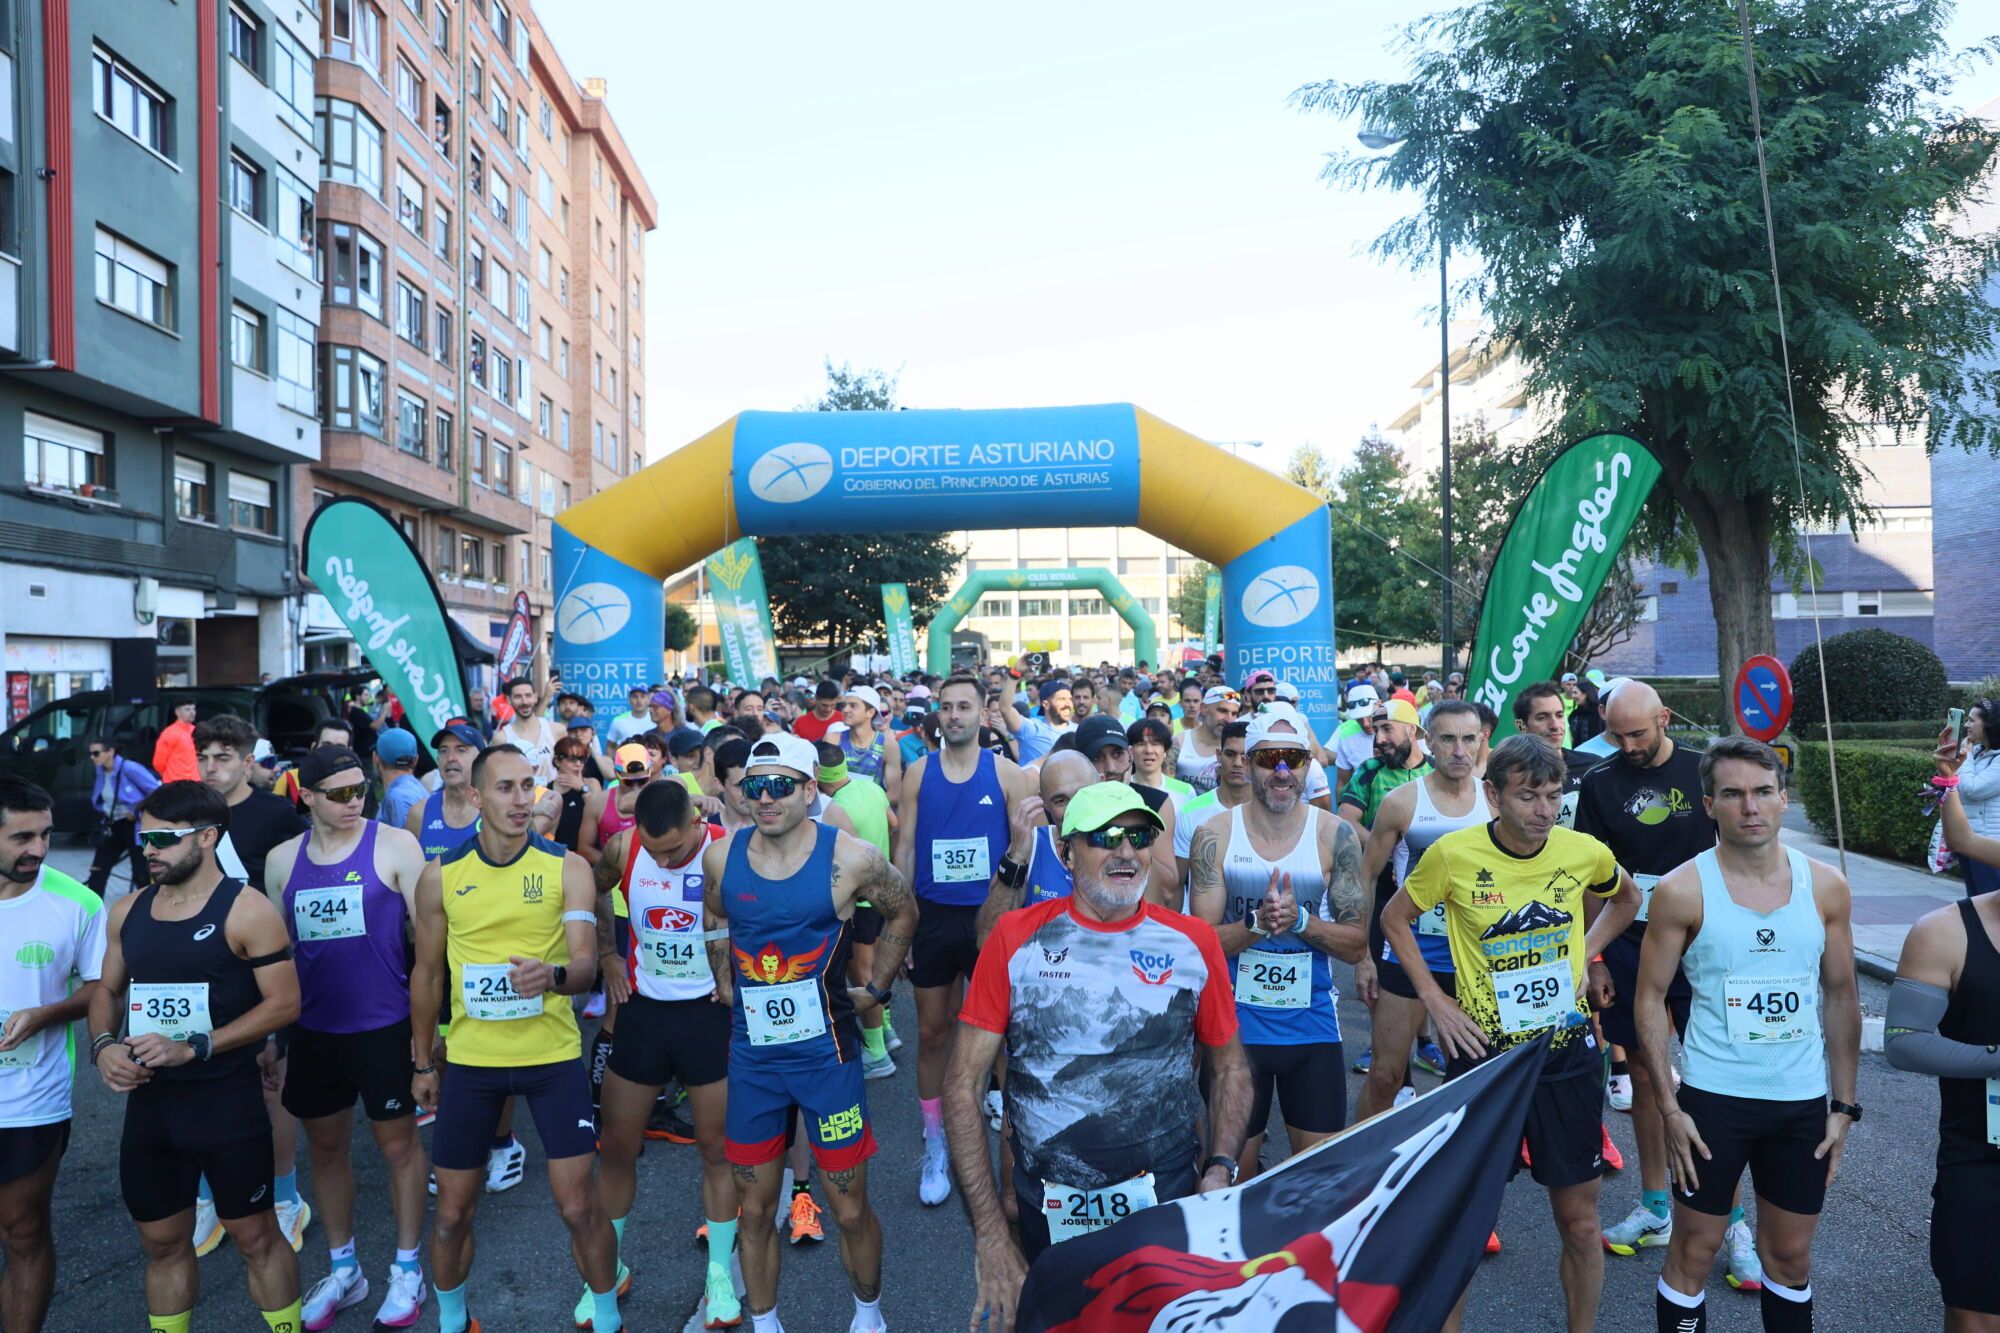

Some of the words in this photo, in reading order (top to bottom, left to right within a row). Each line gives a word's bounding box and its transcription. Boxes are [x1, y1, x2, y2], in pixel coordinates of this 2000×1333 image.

[841, 445, 960, 469] DEPORTE
[968, 439, 1115, 465] ASTURIANO
[844, 477, 912, 492] GOBIERNO
[915, 478, 939, 490] DEL
[941, 475, 1018, 490] PRINCIPADO
[1021, 474, 1038, 487] DE
[1044, 472, 1110, 486] ASTURIAS
[1491, 592, 1558, 684] Corte
[1239, 646, 1334, 665] DEPORTE
[945, 849, 976, 864] 357
[309, 898, 348, 918] 244
[656, 942, 694, 959] 514
[1129, 950, 1175, 972] Rock
[1039, 971, 1071, 979] FASTER
[1148, 972, 1158, 980] fm
[1253, 964, 1297, 985] 264
[480, 976, 519, 996] 24
[1514, 977, 1559, 1004] 259
[147, 998, 191, 1018] 353
[766, 998, 796, 1019] 60
[1532, 1001, 1549, 1009] IBAI
[1747, 992, 1799, 1014] 450
[772, 1018, 795, 1026] KAKO
[1765, 1015, 1787, 1023] ERIC
[818, 1103, 860, 1128] LIONS
[820, 1114, 863, 1142] OCR
[1068, 1193, 1131, 1217] 218
